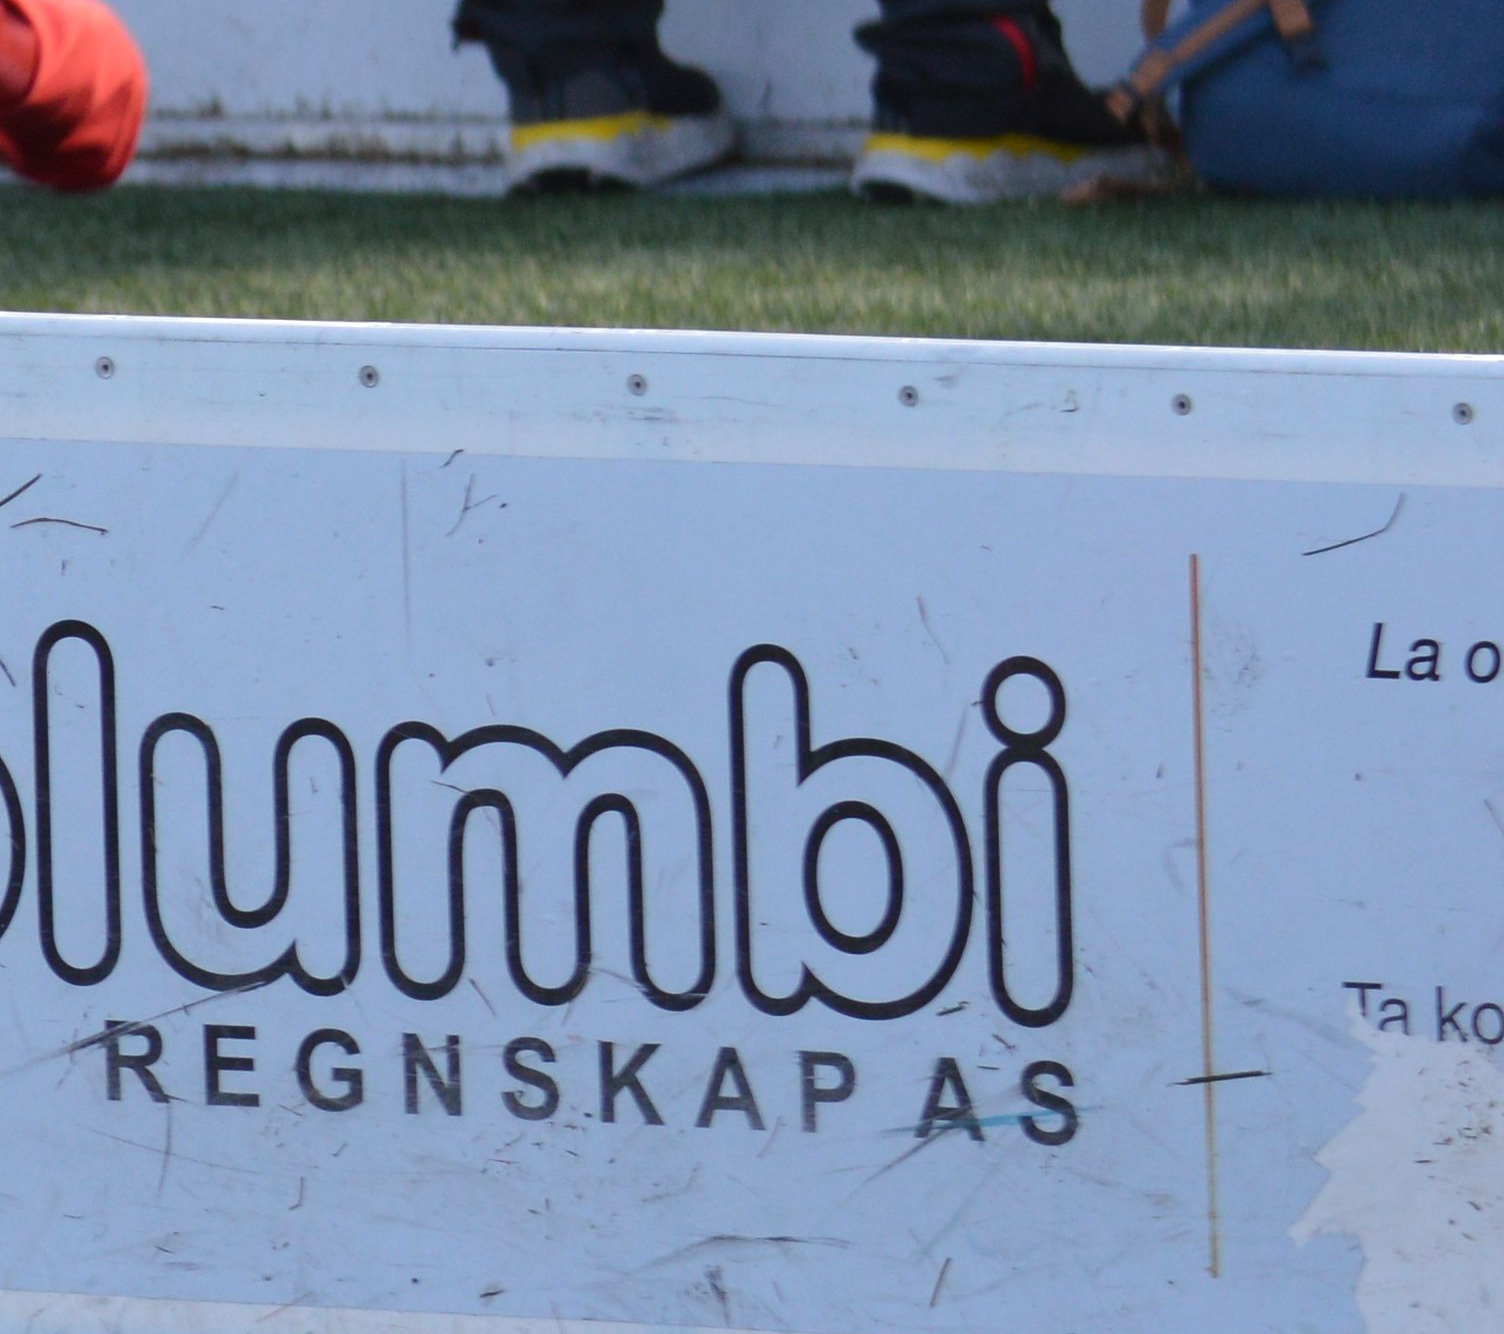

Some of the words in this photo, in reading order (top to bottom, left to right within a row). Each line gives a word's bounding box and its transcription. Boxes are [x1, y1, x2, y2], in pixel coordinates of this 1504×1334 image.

[1366, 622, 1442, 682] La
[104, 1019, 856, 1134] REGNSKAP
[913, 1057, 1079, 1147] AS
